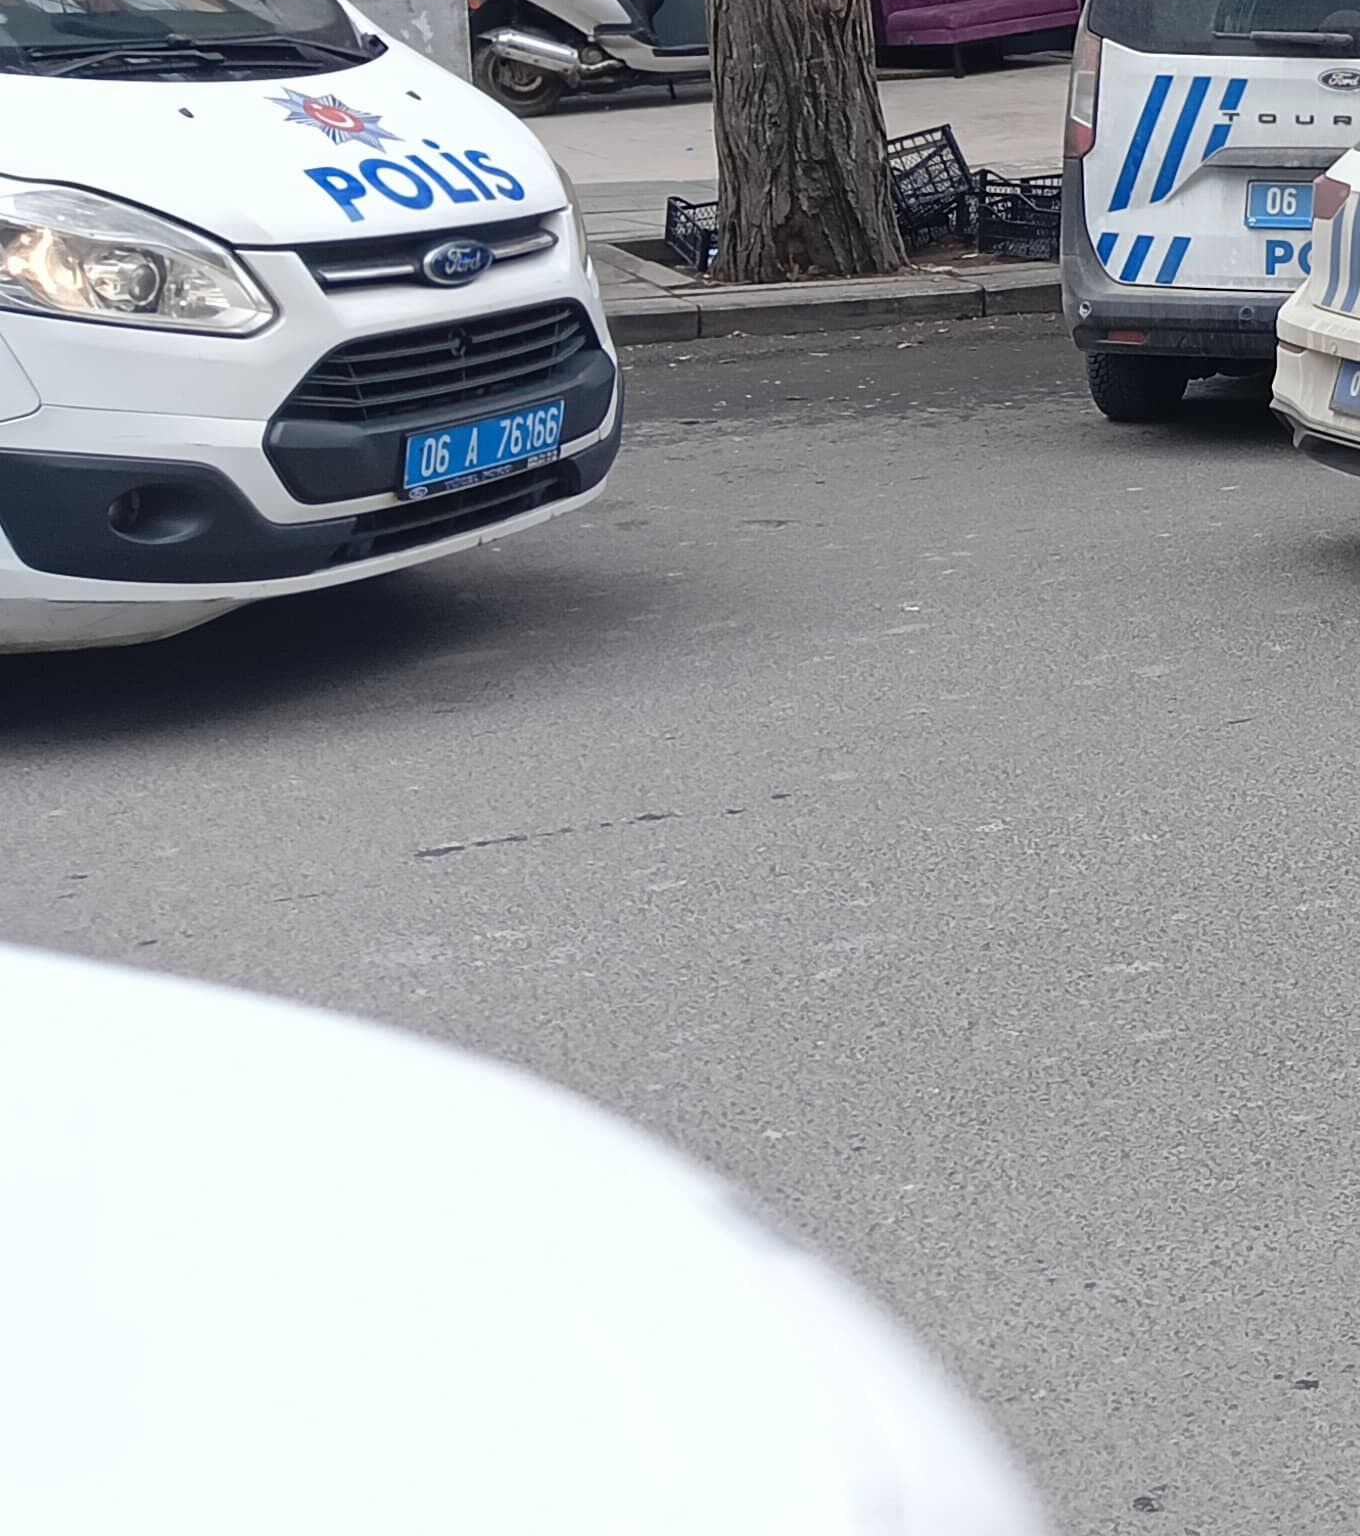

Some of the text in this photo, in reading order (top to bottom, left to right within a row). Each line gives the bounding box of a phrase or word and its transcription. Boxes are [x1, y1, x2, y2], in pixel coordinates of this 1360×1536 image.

[303, 138, 526, 223] POLİS
[1266, 186, 1298, 215] 06
[444, 247, 482, 275] Ford
[420, 434, 452, 478] 06
[465, 427, 479, 468] A
[496, 407, 559, 459] 76166
